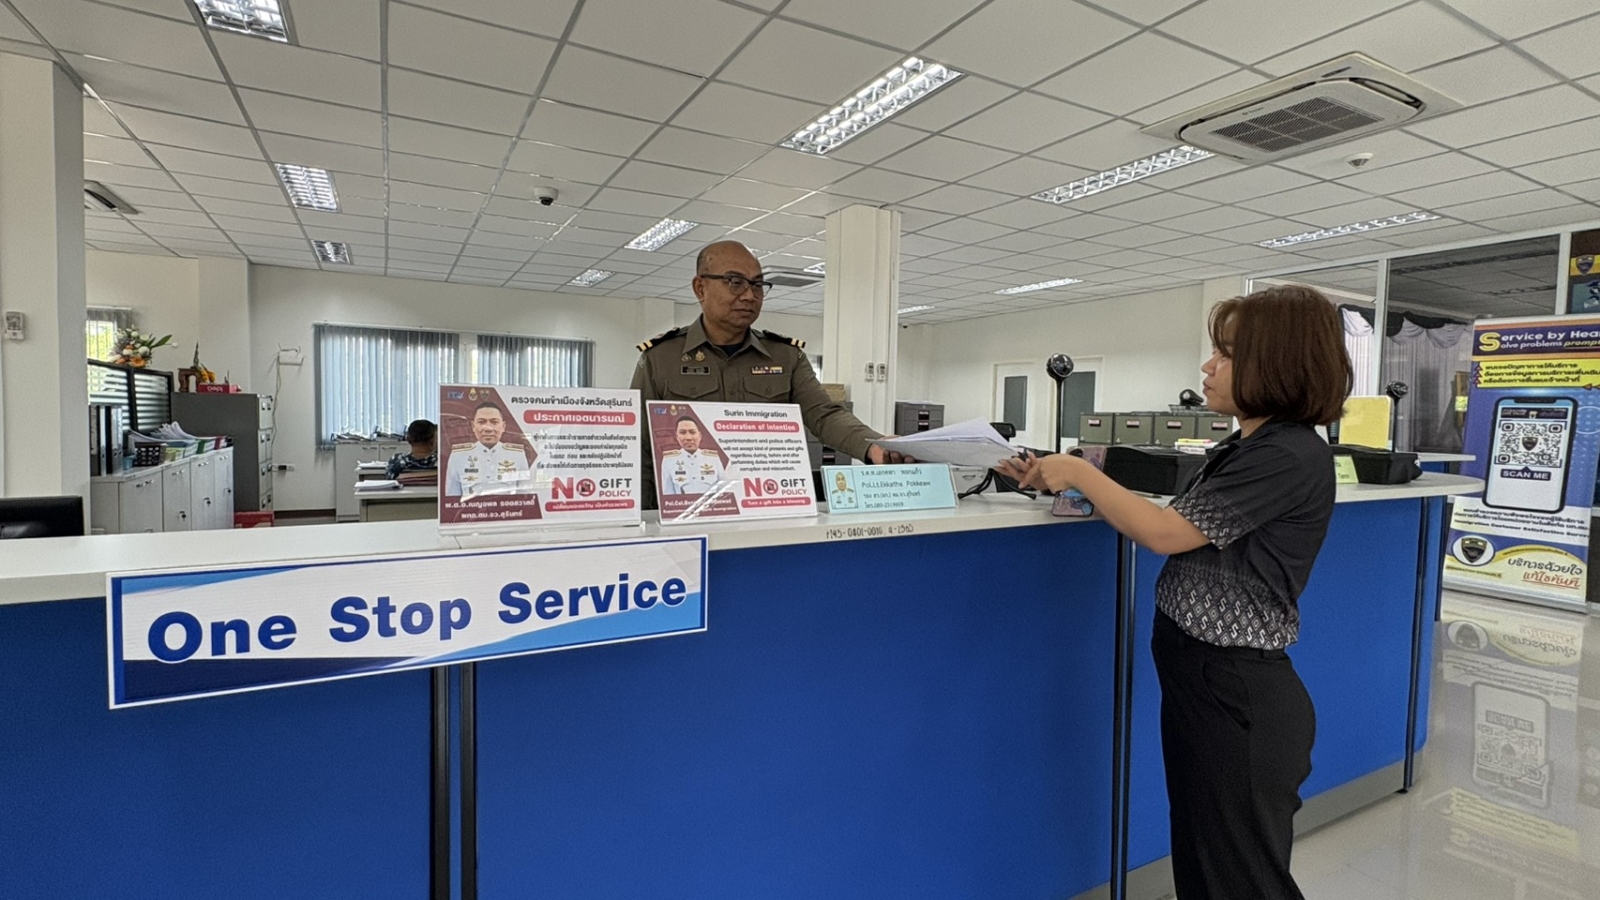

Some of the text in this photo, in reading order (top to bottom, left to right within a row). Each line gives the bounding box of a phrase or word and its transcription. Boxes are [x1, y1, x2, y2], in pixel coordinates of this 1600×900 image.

[1548, 332, 1565, 340] by
[1520, 340, 1562, 349] problems
[511, 395, 632, 409] ตรวจคนเข้าเมืองจังหวัดสุรินทร์
[533, 412, 626, 422] ประกาศเจตนารมณ์
[745, 410, 787, 418] Immigration
[1502, 470, 1549, 480] SCAN ME
[599, 478, 632, 488] GIFT
[780, 478, 806, 488] GIFT
[1508, 557, 1583, 576] บริการด้วยใจ
[1523, 571, 1582, 588] แก้ไขทันที
[147, 572, 687, 662] One Stop Service
